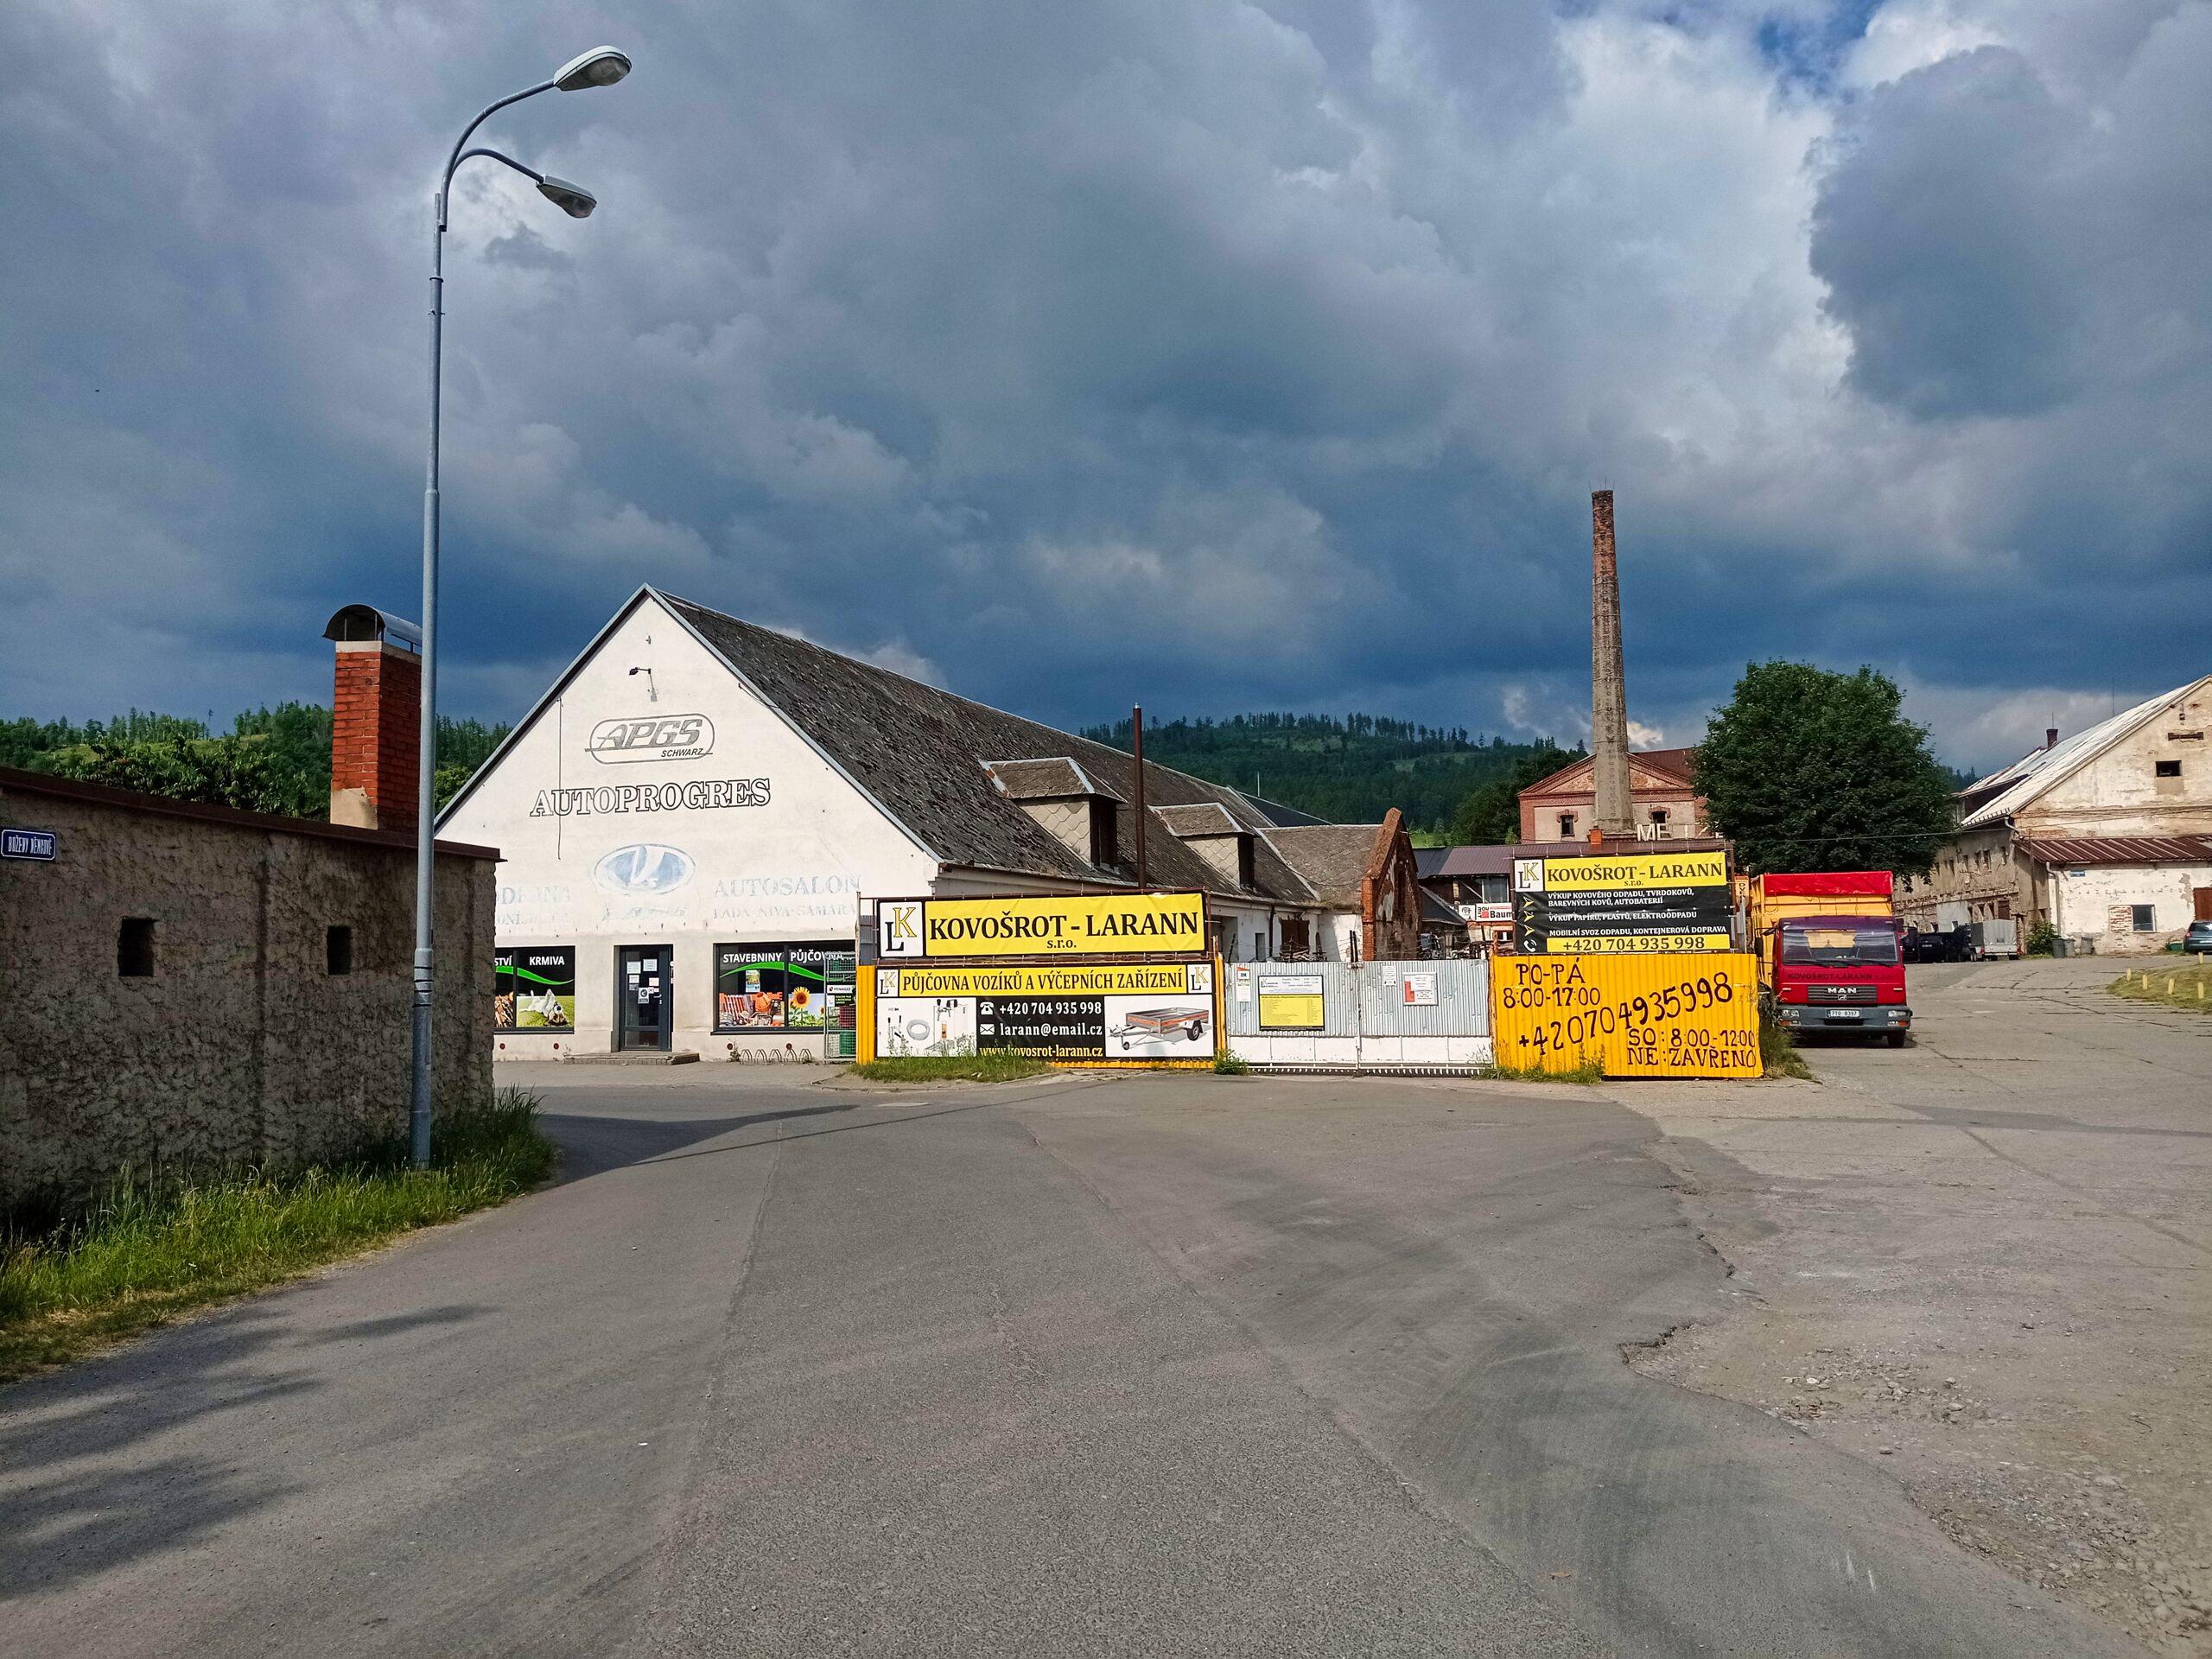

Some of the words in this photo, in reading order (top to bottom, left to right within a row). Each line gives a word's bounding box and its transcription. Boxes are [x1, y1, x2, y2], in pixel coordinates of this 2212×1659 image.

[596, 719, 703, 750] APGS
[661, 747, 705, 758] SCHWARZ
[530, 779, 771, 817] AUTOPROGRES
[1547, 864, 1637, 882] KOVOŠROT
[1649, 862, 1722, 879] LARANN
[715, 874, 861, 898] AUTOSALON
[1646, 887, 1694, 897] TVRDOKOVŮ,
[1548, 899, 1590, 907] BAREVNÝCH
[1614, 896, 1663, 906] AUTOBATERIÍ
[1633, 911, 1697, 919] ELEKTROODPADU
[929, 911, 1067, 940] KOVOŠROT
[1085, 912, 1198, 937] LARANN
[1549, 928, 1580, 937] MOBILNÍ
[1633, 925, 1689, 935] KONTEJNEROVÁ
[1046, 939, 1077, 949] s.r.o.
[1563, 938, 1601, 951] +420
[1605, 938, 1636, 950] 704
[1640, 938, 1669, 950] 935
[1675, 937, 1705, 949] 998
[529, 956, 565, 966] KRMIVA
[723, 952, 783, 963] STAVEBNINY
[903, 972, 970, 994] PŮJČOVNA
[972, 970, 1022, 990] VOZÍKŮ
[1026, 976, 1034, 989] A
[1038, 969, 1113, 989] VÝČEPNÍCH
[1117, 968, 1182, 988] ZAŘÍZENÍ
[999, 1002, 1027, 1014] +420
[1032, 1002, 1052, 1014] 704
[1057, 1001, 1077, 1014] 935
[1080, 1001, 1102, 1014] 998
[1000, 1023, 1103, 1037] larann@email.cz
